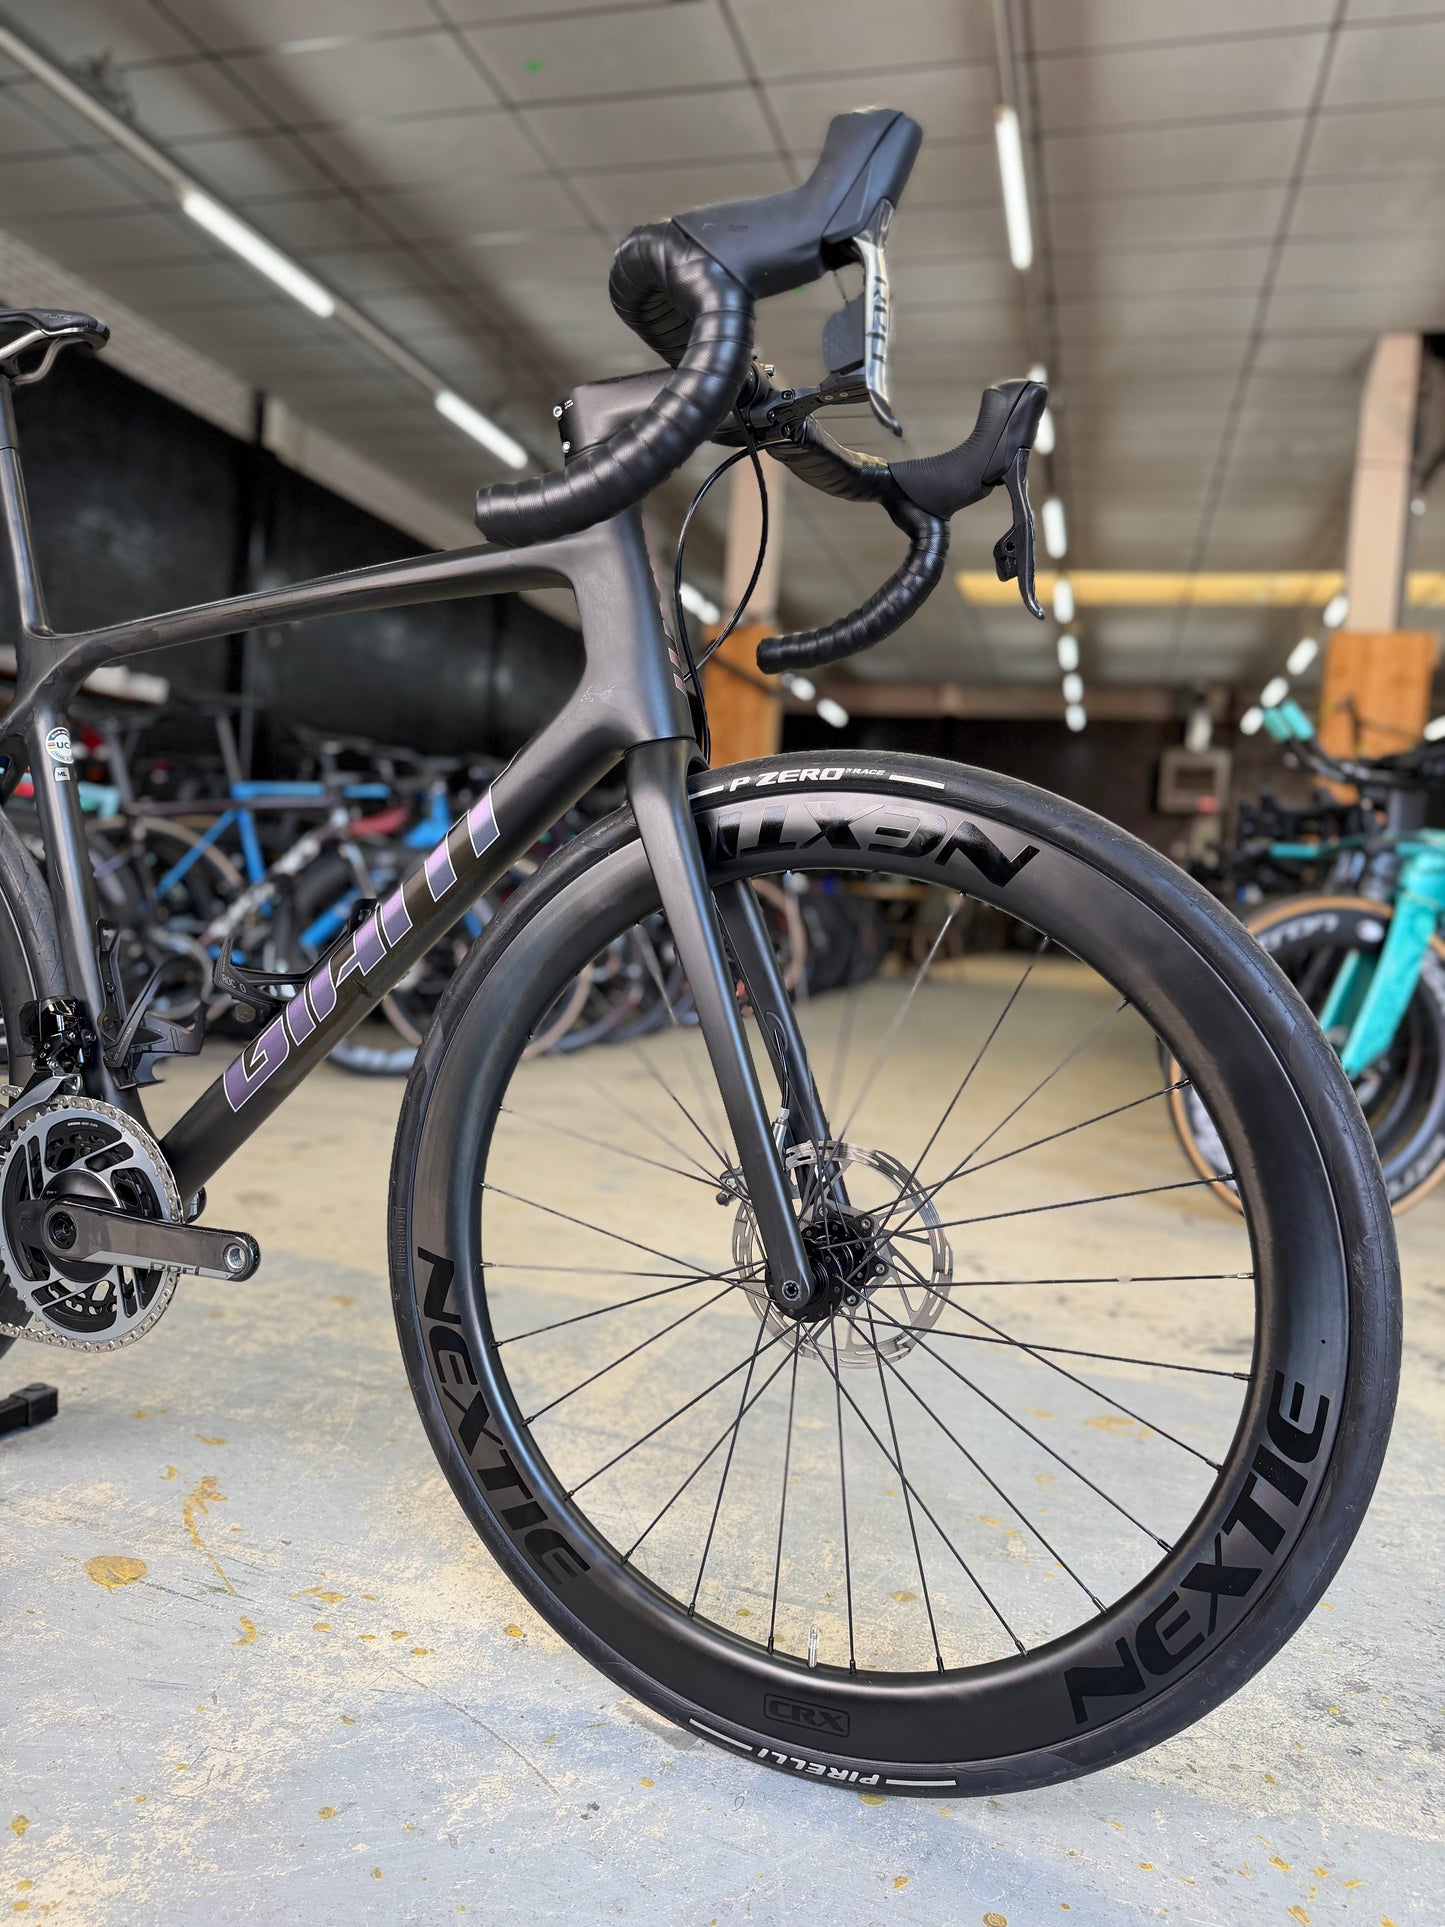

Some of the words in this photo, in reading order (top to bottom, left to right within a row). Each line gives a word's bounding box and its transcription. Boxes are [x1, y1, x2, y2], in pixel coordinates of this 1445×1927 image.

[729, 776, 751, 792] P
[755, 767, 845, 787] ZERO
[417, 1246, 592, 1585] NEXTIE
[1063, 1369, 1331, 1725] NEXTIE
[768, 1700, 846, 1733] CRX
[756, 1747, 880, 1786] PIRELLI
